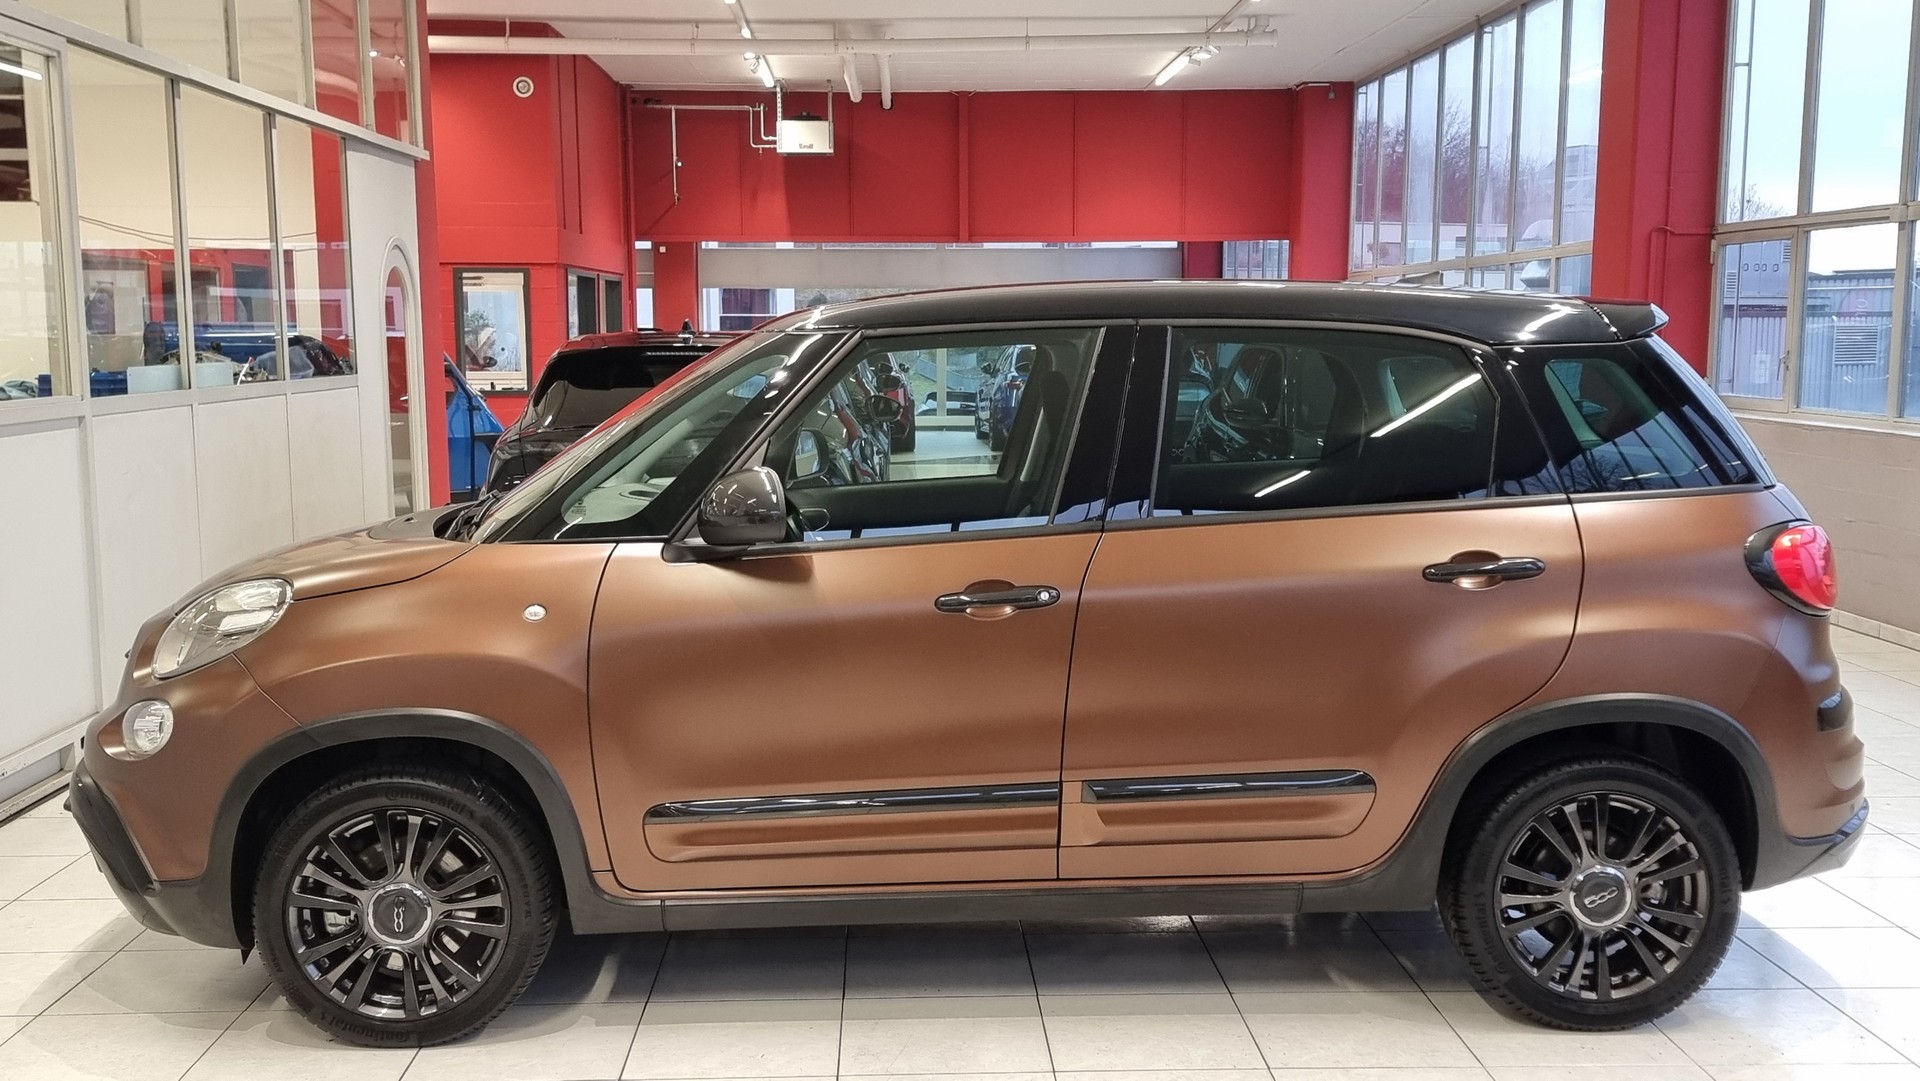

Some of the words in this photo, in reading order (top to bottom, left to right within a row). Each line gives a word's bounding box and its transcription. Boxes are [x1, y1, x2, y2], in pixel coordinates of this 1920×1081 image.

[1582, 886, 1619, 909] 500
[392, 895, 406, 934] 500
[328, 1014, 411, 1043] Continental
